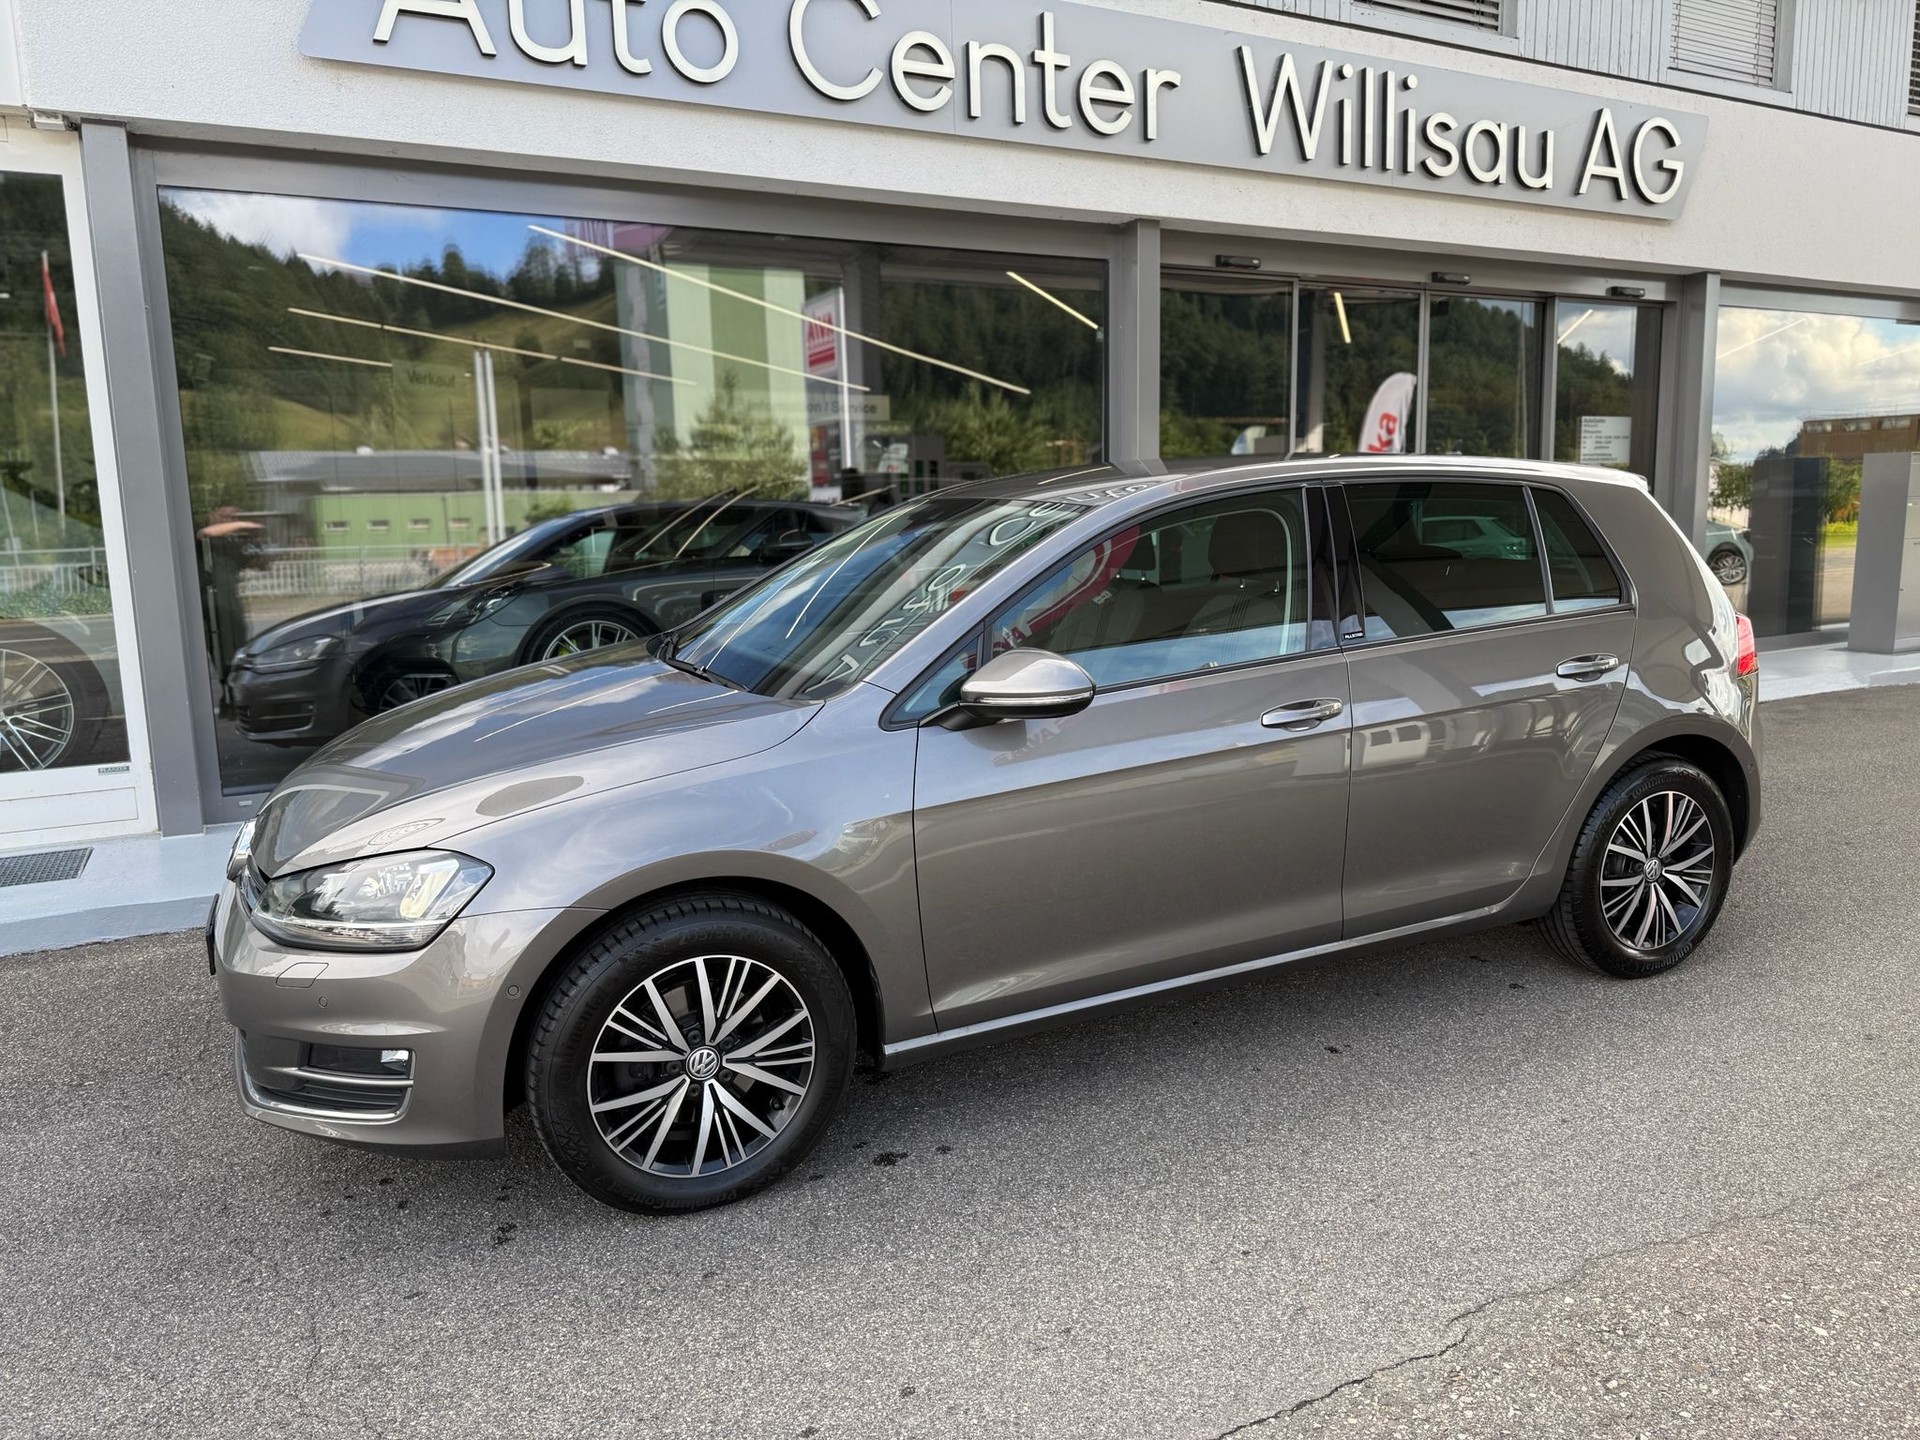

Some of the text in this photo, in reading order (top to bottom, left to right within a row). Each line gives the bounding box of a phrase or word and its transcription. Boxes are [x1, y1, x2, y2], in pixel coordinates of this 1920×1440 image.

[789, 0, 1182, 141] Center
[1235, 44, 1554, 190] Willisau
[1576, 107, 1685, 205] AG
